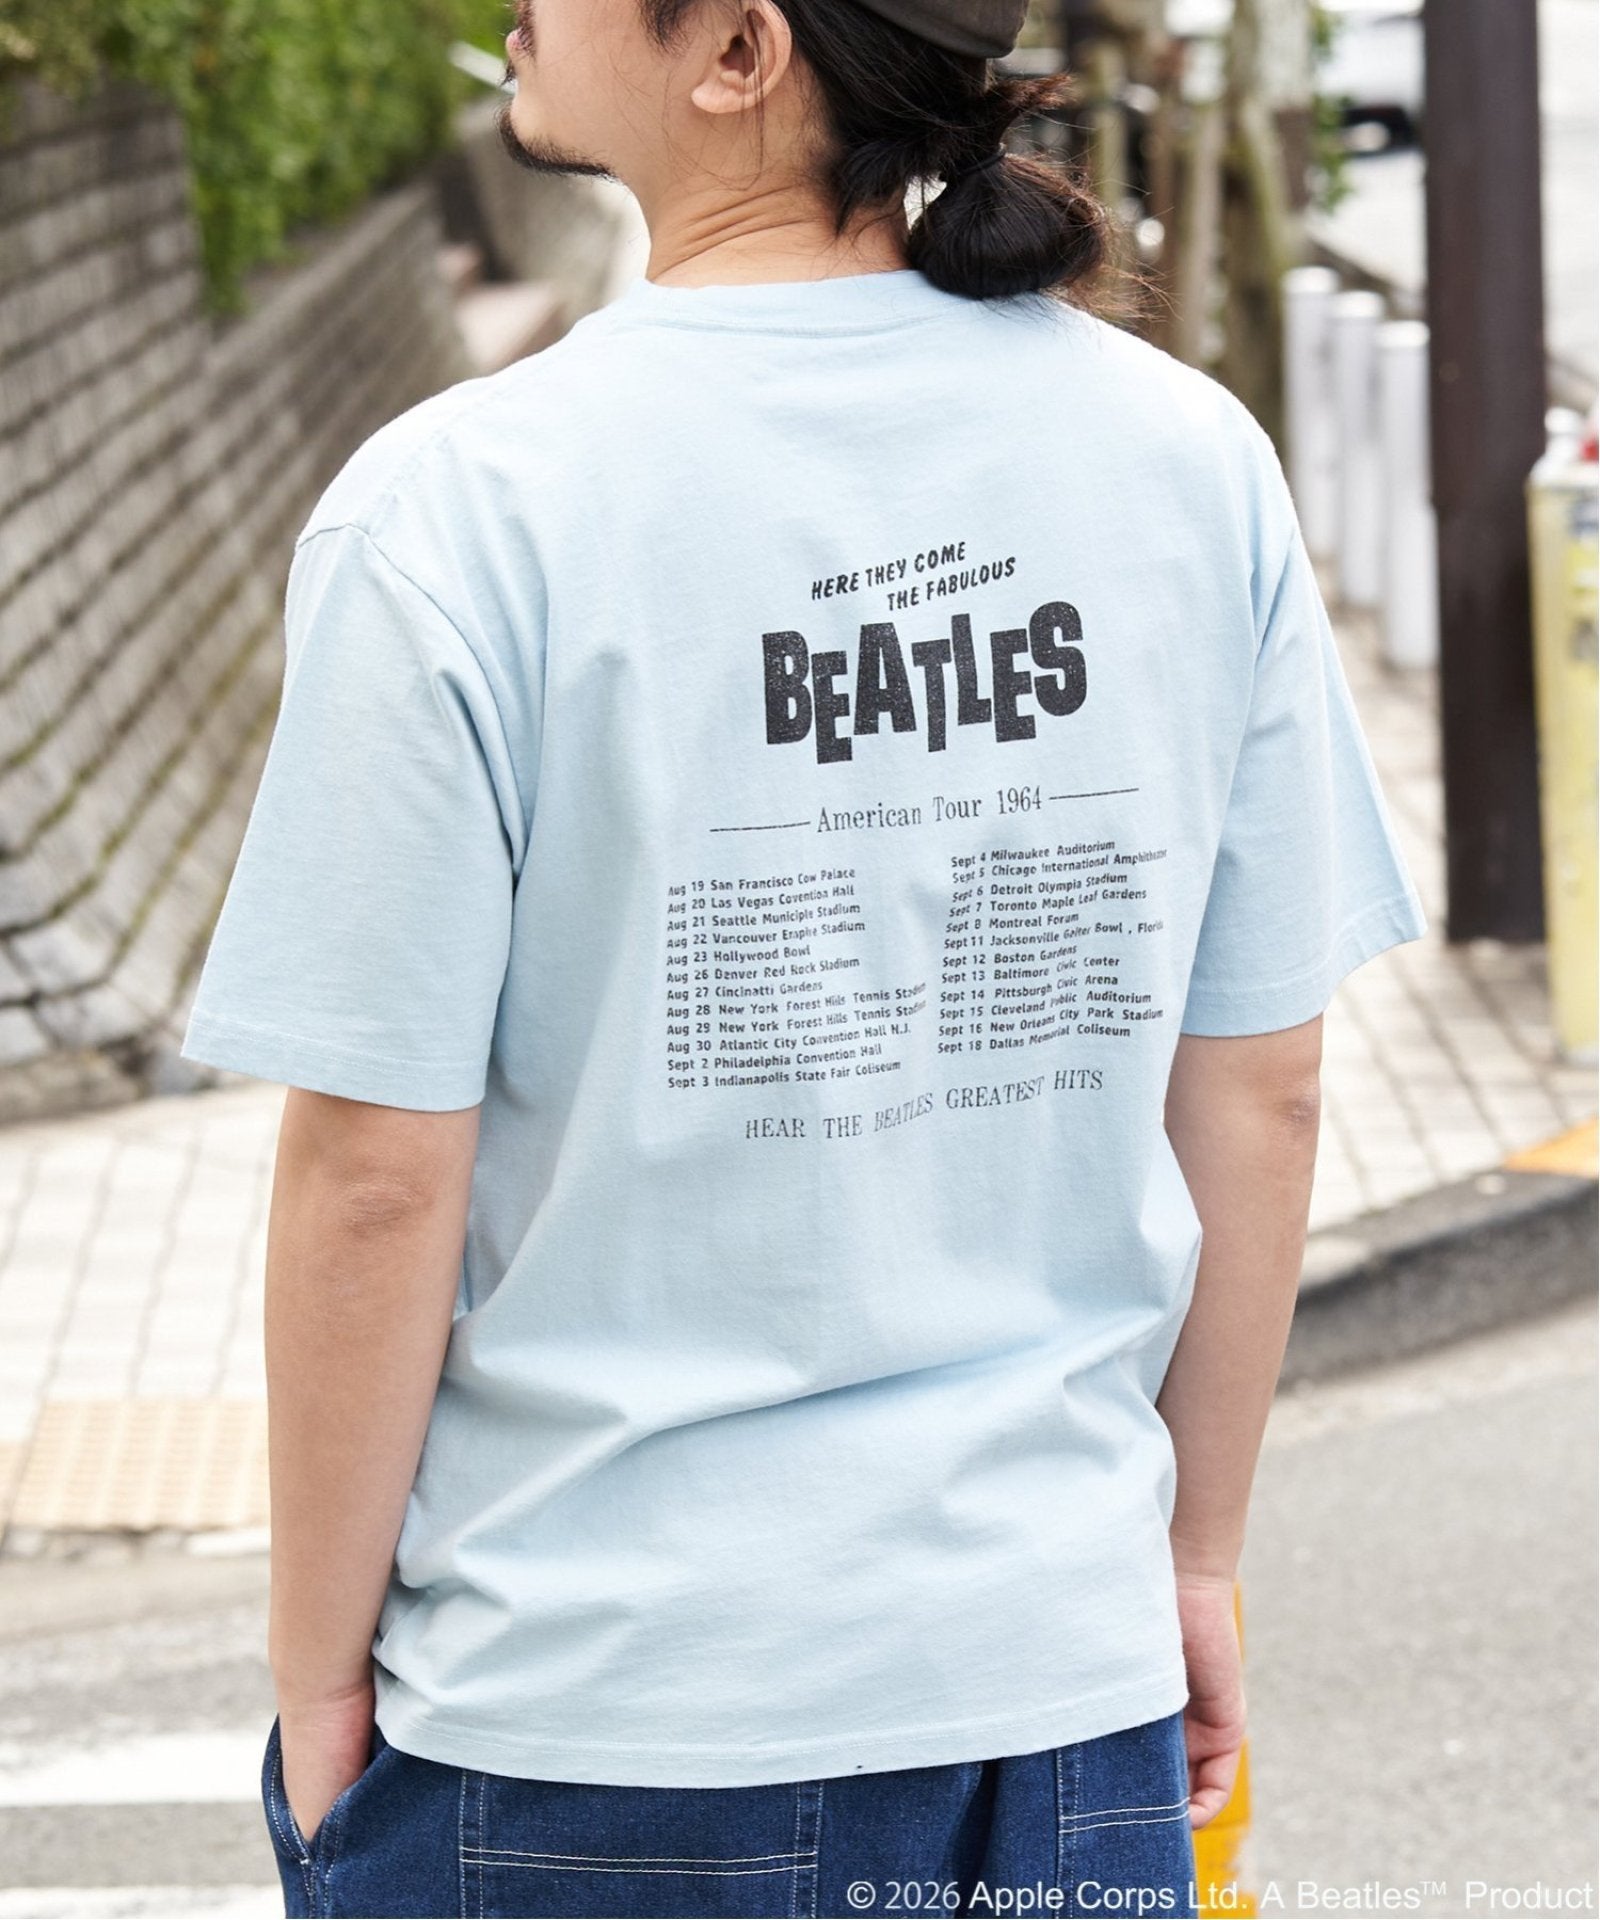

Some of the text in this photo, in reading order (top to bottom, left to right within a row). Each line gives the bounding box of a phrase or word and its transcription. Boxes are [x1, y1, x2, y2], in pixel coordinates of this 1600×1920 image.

[811, 541, 965, 601] HERE THEY COME
[887, 557, 1016, 611] THE FABULOUS
[762, 601, 1087, 764] BEATLES
[817, 784, 1043, 833] American Tour 1964
[951, 841, 1115, 868] Sept 4 Milwaukee Auditorium
[953, 871, 975, 883] Sept
[979, 867, 984, 877] 5
[992, 865, 1036, 877] Chicago
[1042, 854, 1109, 872] International
[668, 868, 855, 896] Aug 19 San Francisco Cow Palace
[953, 872, 1127, 902] Sept 6 Detroit Olympia Stadium
[668, 903, 686, 914] Aug
[692, 898, 705, 909] 20
[711, 898, 732, 908] Las
[738, 897, 774, 909] Vegas
[832, 885, 854, 896] Hall
[949, 889, 1146, 917] Sept 7 Toronto Maple Leaf Gardens
[667, 920, 687, 931] Aug
[693, 916, 705, 927] 21
[712, 915, 757, 926] Seattle
[817, 904, 860, 917] Stadium
[946, 921, 968, 933] Sept
[990, 916, 1042, 928] Montreal
[1047, 913, 1079, 925] Forum
[667, 938, 687, 948] Aug
[693, 934, 707, 944] 22
[713, 933, 777, 944] Vancouver
[821, 921, 865, 935] Stadium
[944, 938, 967, 949] Sept
[990, 932, 1059, 946] Jacksonville
[1095, 923, 1122, 933] Bowl
[666, 945, 811, 966] Aug 23 Hollywood Bowl
[942, 945, 1077, 968] Sept 12 Boston Gardens
[667, 973, 688, 983] Aug
[694, 969, 709, 980] 26
[715, 968, 757, 979] Denver
[764, 965, 785, 978] Red
[790, 963, 816, 975] Rock
[942, 956, 1120, 984] Sept 13 Baltimore Civic Center
[667, 990, 689, 1001] Aug
[695, 987, 709, 998] 27
[940, 975, 1118, 1003] Sept 14 Pittsburgh Civic Arena
[667, 1008, 689, 1019] Aug
[696, 1005, 710, 1015] 28
[719, 1005, 744, 1015] New
[751, 1003, 778, 1014] York
[786, 1000, 820, 1011] Forest
[853, 990, 890, 1003] Tennis
[940, 1009, 964, 1020] Sept
[971, 1006, 983, 1016] 15
[991, 1001, 1045, 1016] Cleveland
[1086, 990, 1151, 1003] Auditorium
[667, 1025, 689, 1036] Aug
[696, 1023, 710, 1033] 29
[719, 1023, 745, 1032] New
[751, 1021, 779, 1032] York
[787, 1018, 822, 1029] Forest
[854, 1007, 891, 1021] Tennis
[939, 1025, 963, 1037] Sept
[970, 1023, 982, 1034] 16
[990, 1022, 1014, 1032] New
[1059, 1008, 1079, 1021] City
[1087, 1007, 1114, 1018] Park
[1122, 1009, 1163, 1021] Stadium
[667, 1042, 690, 1054] Aug
[697, 1041, 711, 1051] 30
[720, 1039, 768, 1050] Atlantic
[774, 1038, 797, 1049] City
[803, 1030, 860, 1046] Convention
[865, 1025, 887, 1037] Hall
[938, 1041, 962, 1054] Sept
[969, 1040, 982, 1051] 18
[990, 1038, 1024, 1050] Dallas
[1077, 1023, 1130, 1037] Coliseum
[667, 1044, 882, 1071] Sept 2 Philadelphia Convention Hall
[668, 1062, 901, 1088] Sept 3 Indianapolis State Fair Coliseum
[745, 1069, 1103, 1139] HEAR THE BEATLES GREATEST HITS
